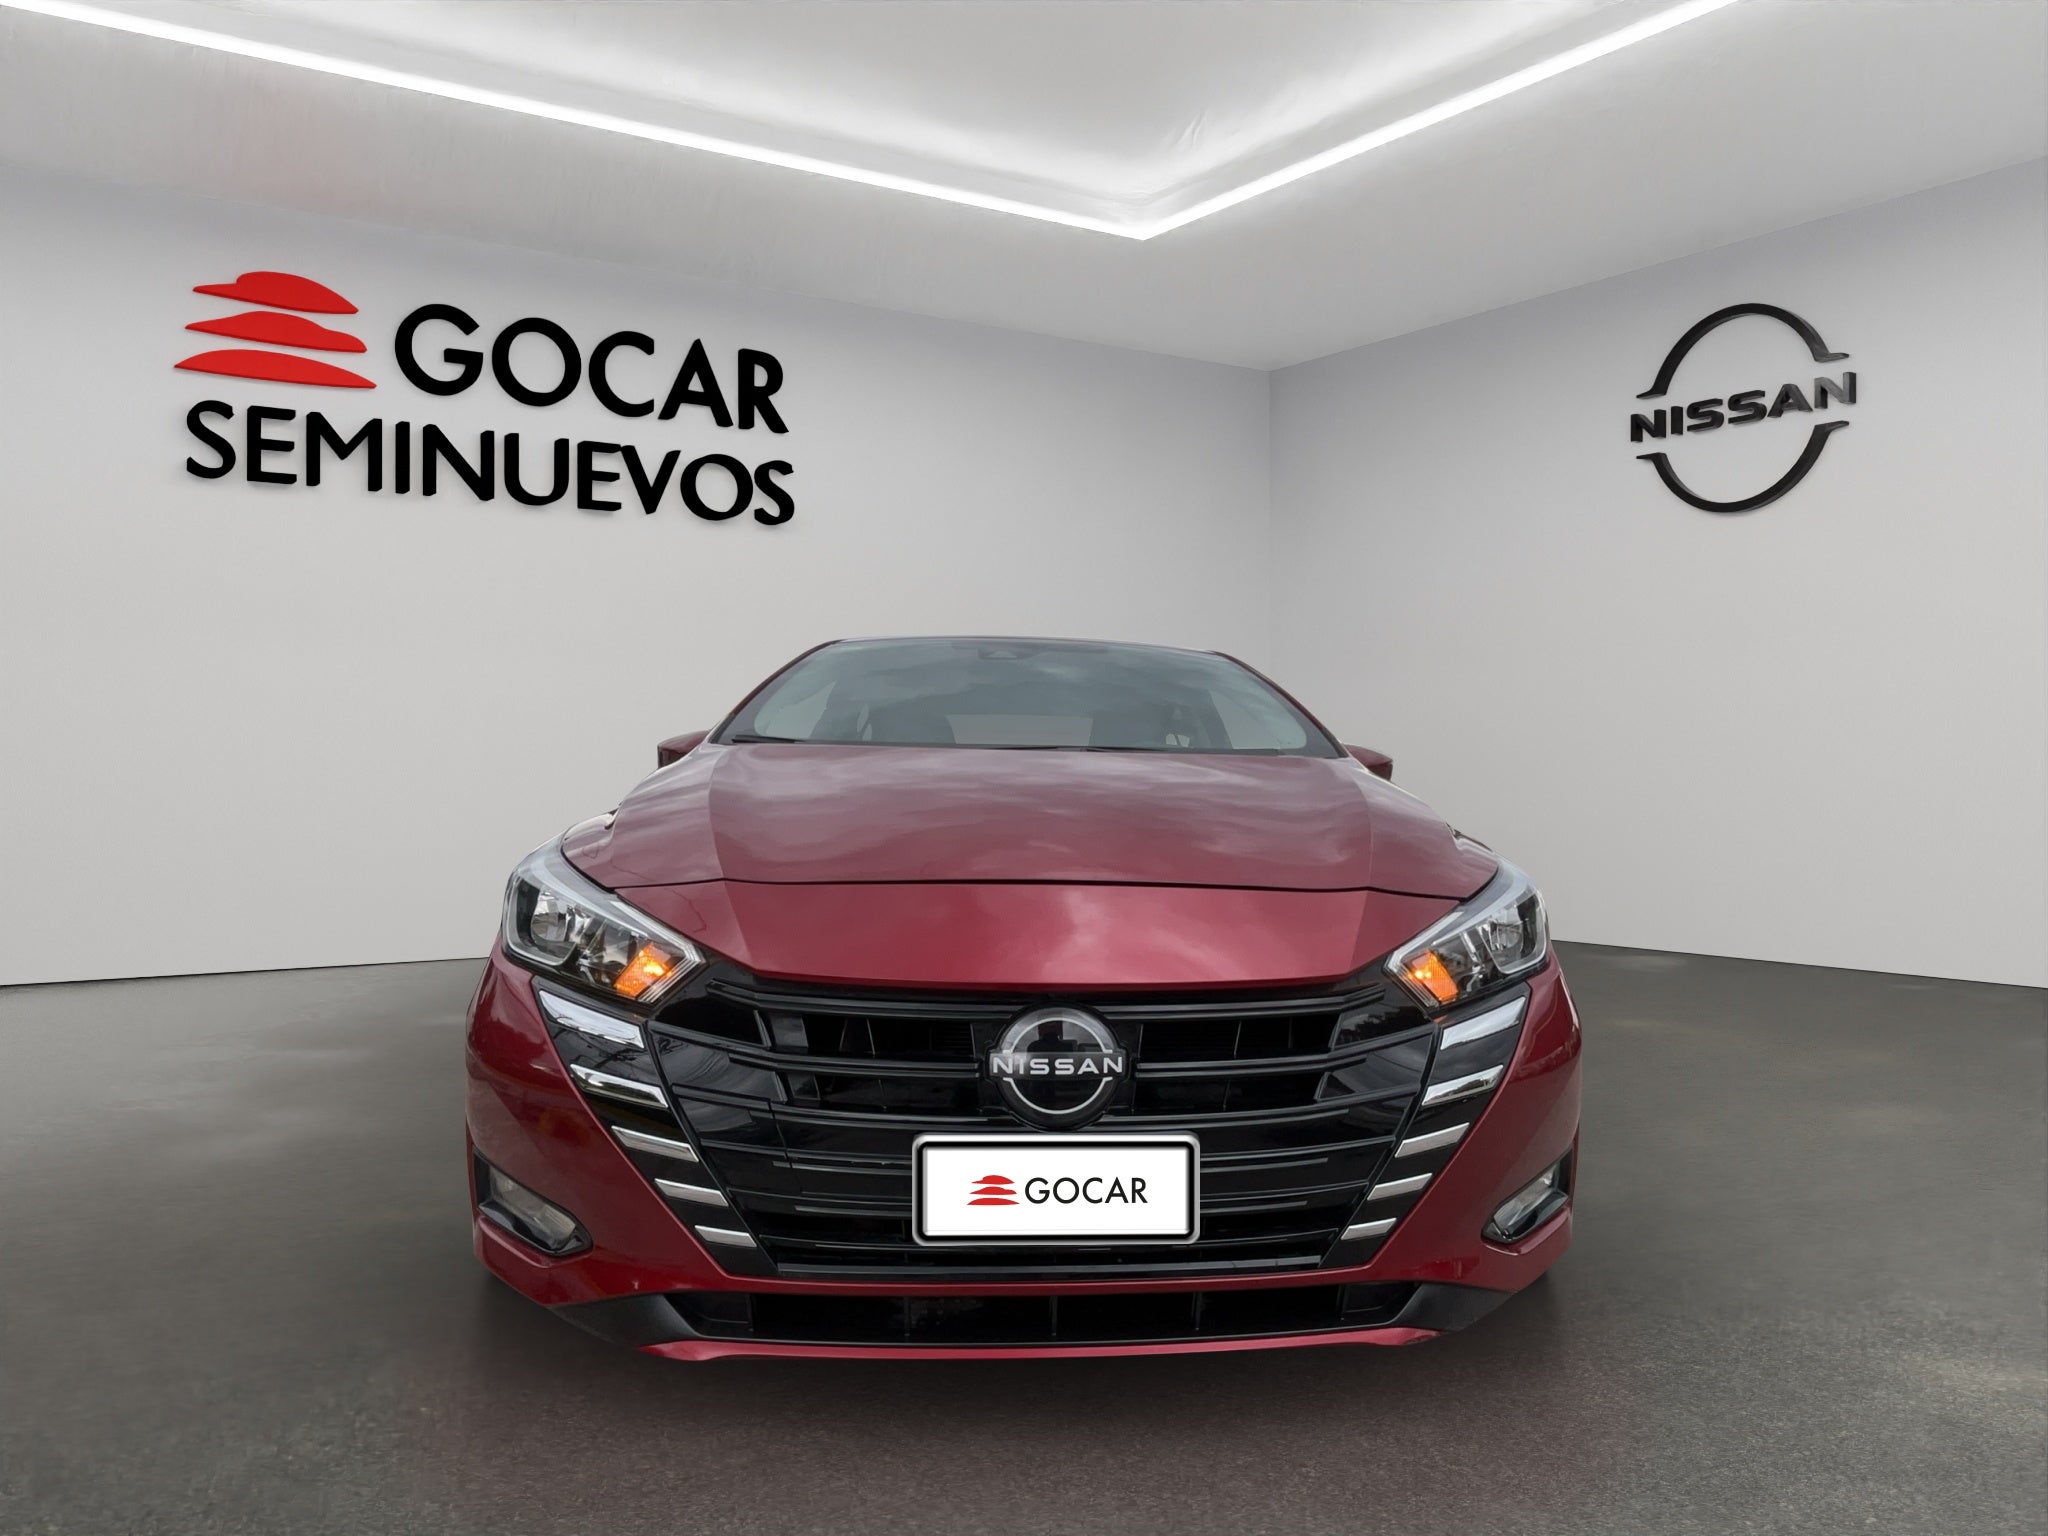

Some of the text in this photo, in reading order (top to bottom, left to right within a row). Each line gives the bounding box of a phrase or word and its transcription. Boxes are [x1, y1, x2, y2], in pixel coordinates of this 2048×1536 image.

[394, 303, 790, 435] GOCAR
[1630, 371, 1857, 444] NISSAN
[186, 399, 796, 527] SEMINUEVOS
[992, 1056, 1123, 1075] NISSAN
[1024, 1176, 1148, 1204] GOCAR
